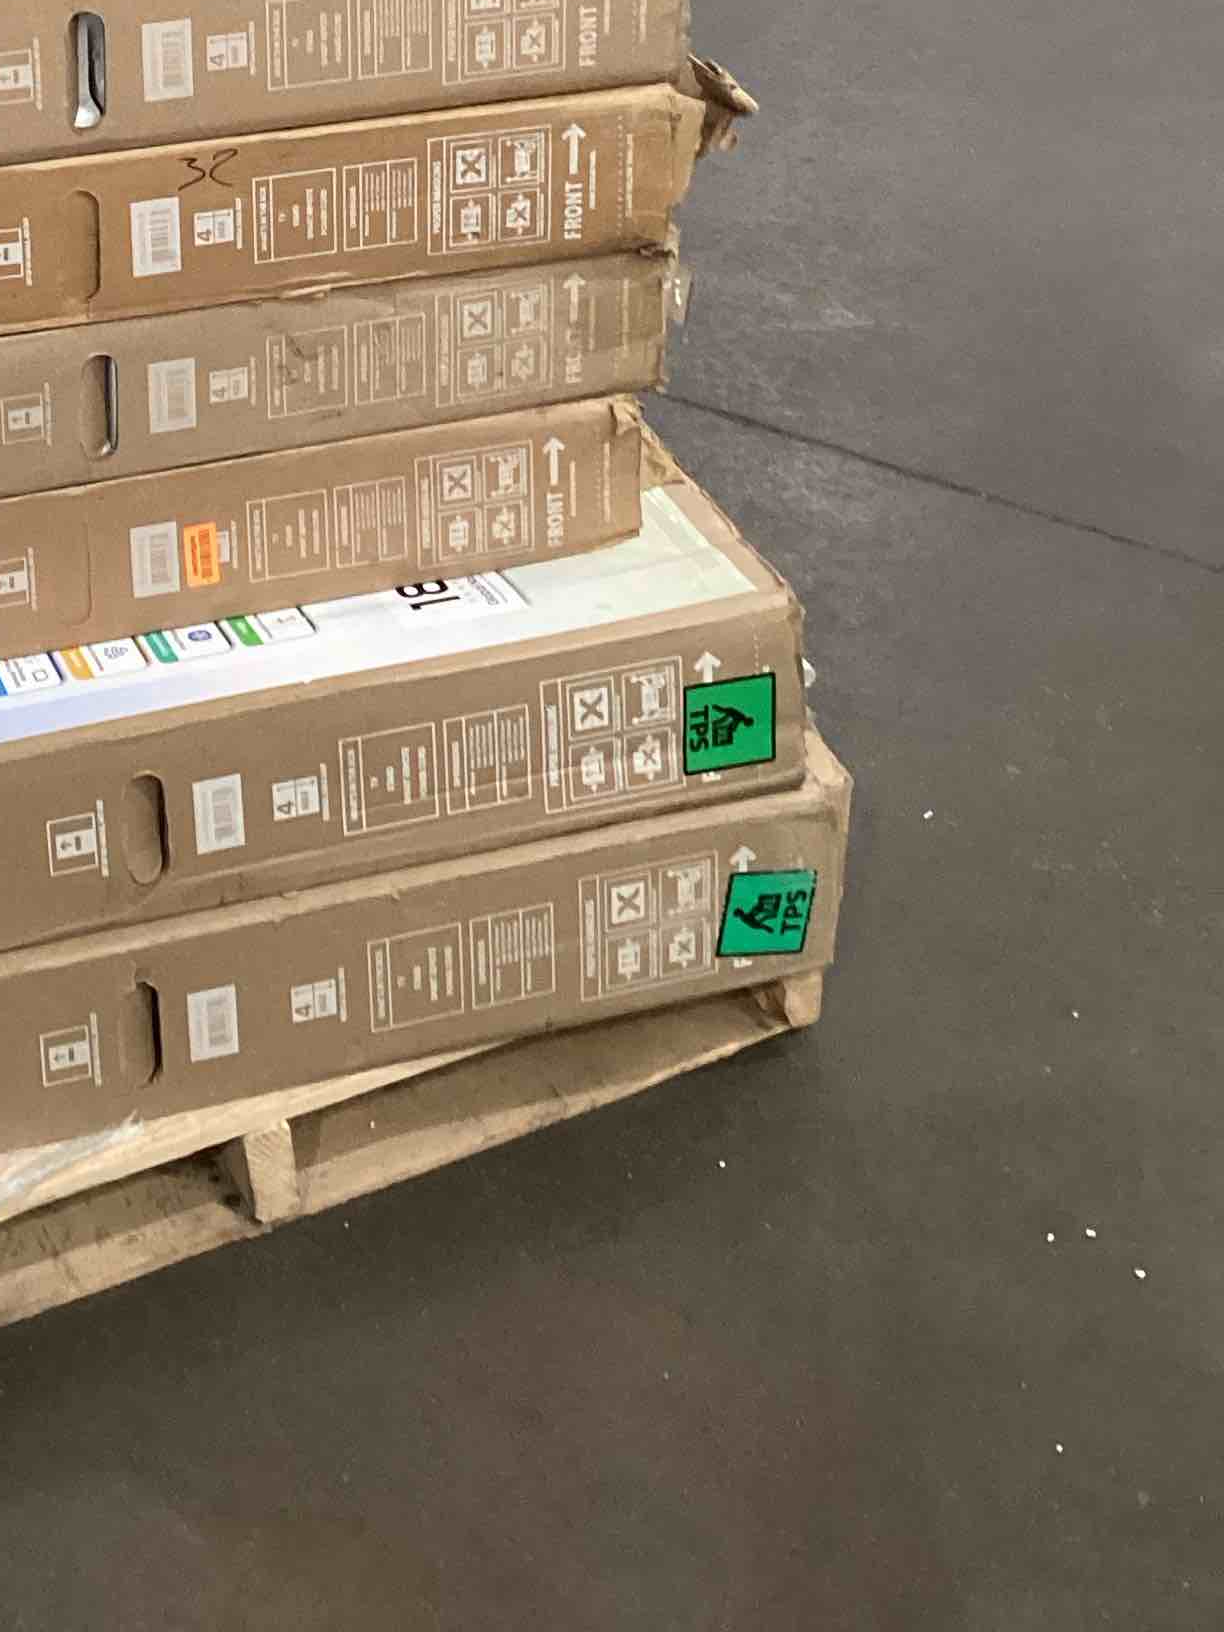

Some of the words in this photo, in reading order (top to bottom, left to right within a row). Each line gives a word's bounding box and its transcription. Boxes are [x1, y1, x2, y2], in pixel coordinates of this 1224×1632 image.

[578, 3, 598, 67] FRONT
[196, 228, 213, 243] 4
[563, 179, 584, 241] FRONT
[546, 492, 564, 549] FRONT
[690, 710, 710, 754] TPS
[779, 889, 810, 935] TPS
